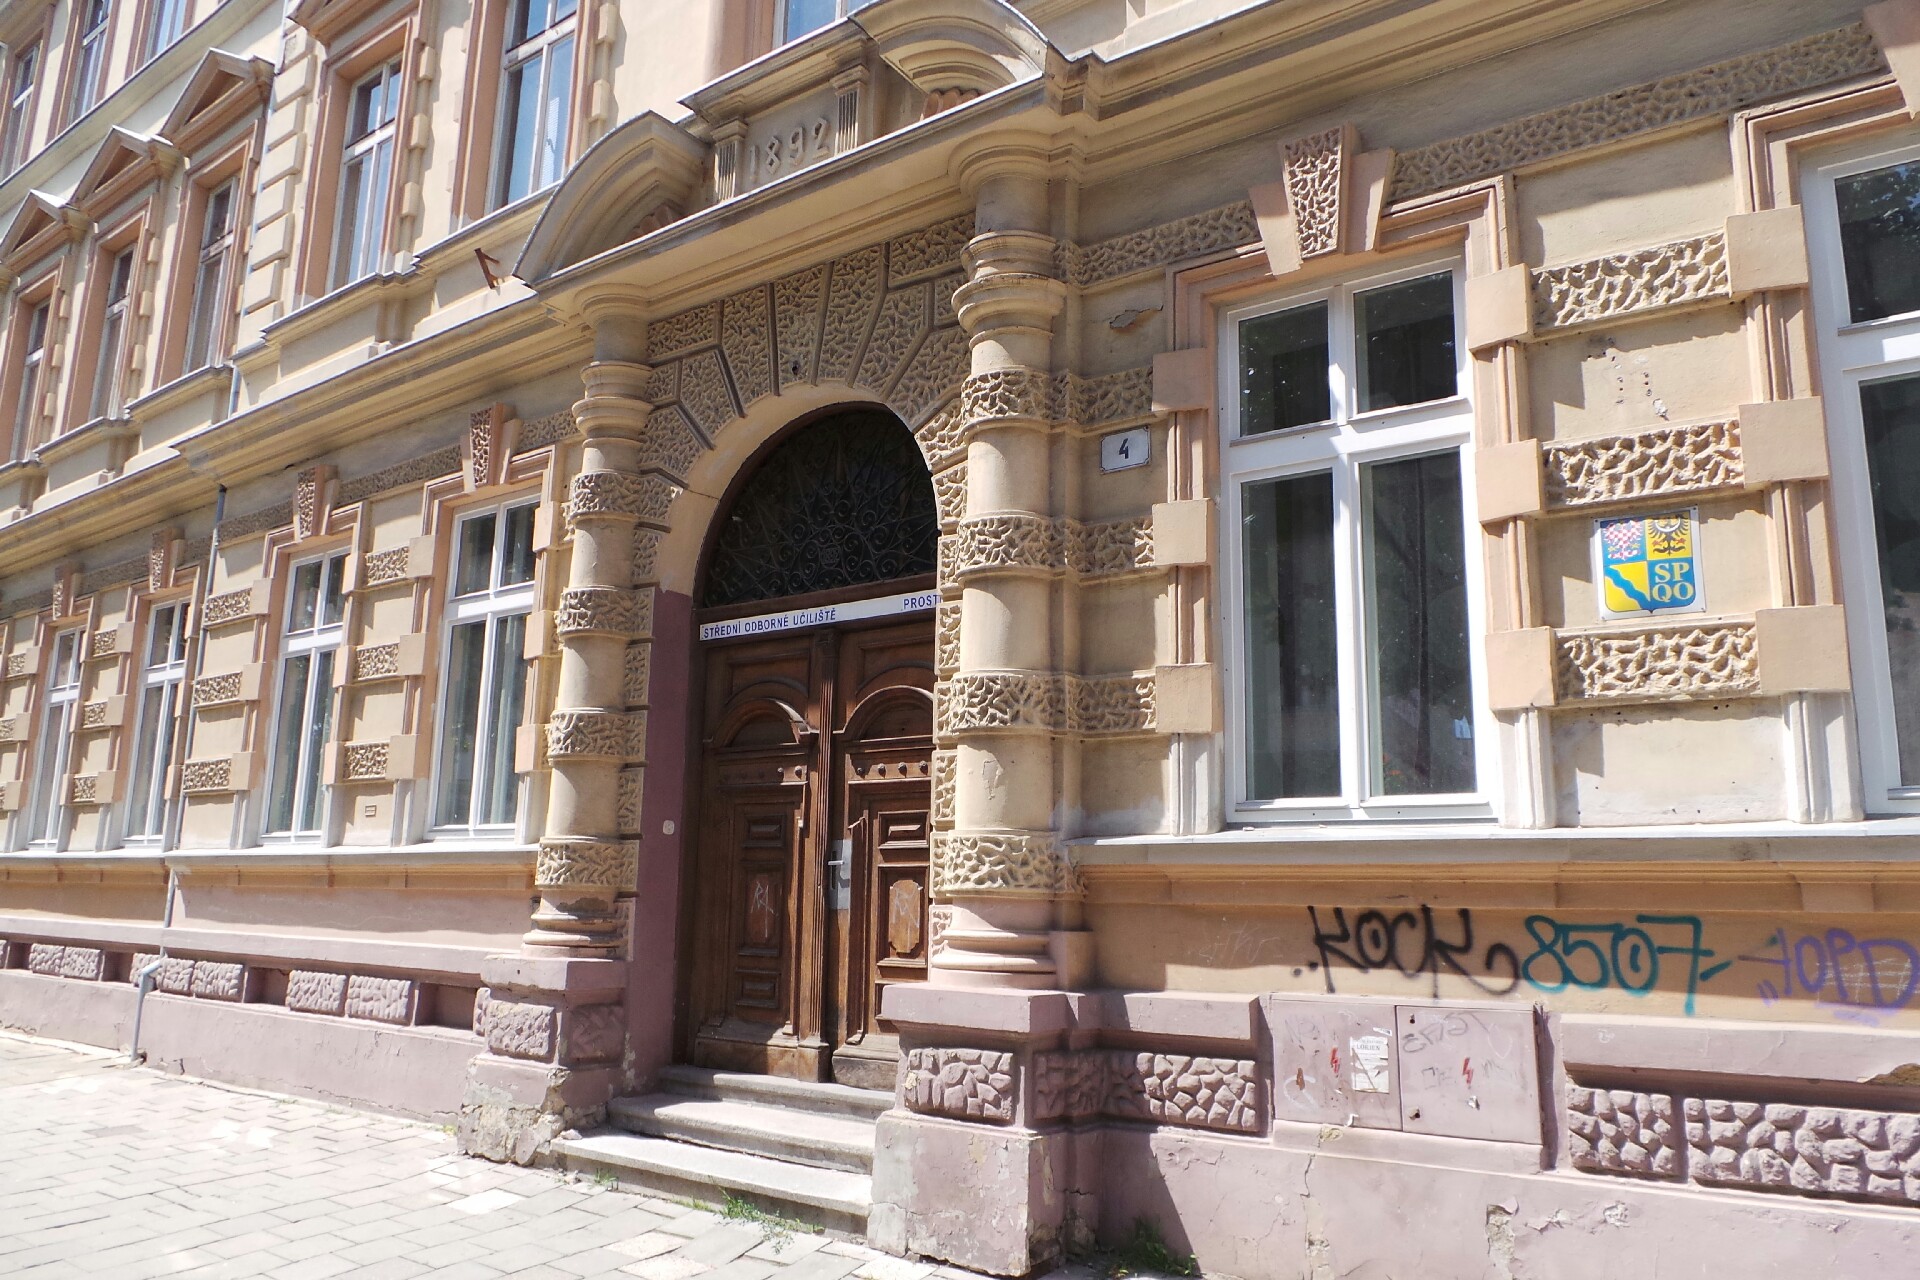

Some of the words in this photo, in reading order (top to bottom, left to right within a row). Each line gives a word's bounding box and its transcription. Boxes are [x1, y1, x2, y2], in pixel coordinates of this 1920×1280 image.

[749, 117, 829, 182] 1892
[1118, 437, 1129, 460] 4
[1654, 562, 1690, 584] SP
[1652, 581, 1694, 603] QO
[703, 621, 741, 639] STŘEDNÍ
[744, 614, 789, 632] ODBORNÉ
[793, 609, 836, 626] UČILIŠTĚ
[903, 594, 942, 610] PROST
